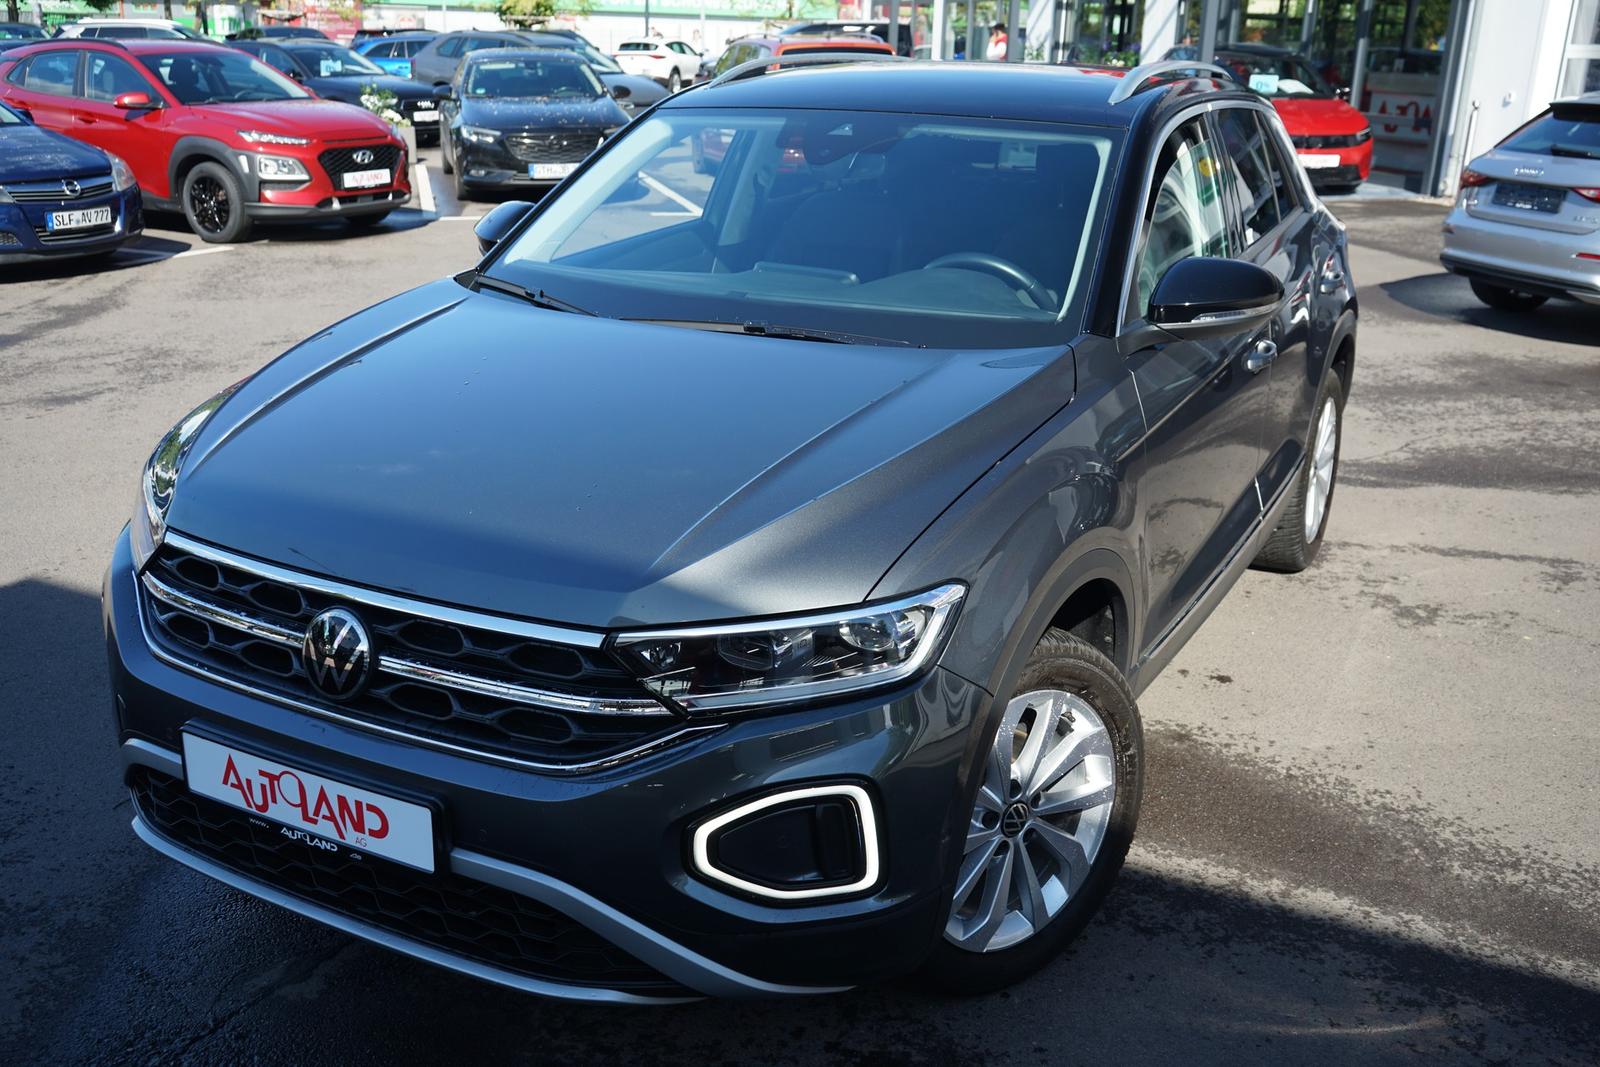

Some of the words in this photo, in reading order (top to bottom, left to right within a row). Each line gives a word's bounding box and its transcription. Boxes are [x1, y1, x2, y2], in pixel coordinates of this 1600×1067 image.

[54, 214, 73, 227] SLF
[81, 211, 92, 223] AV
[94, 209, 109, 222] 777
[222, 753, 390, 840] AUTOLAND
[355, 837, 368, 848] AG
[281, 827, 338, 852] AUTOLAND
